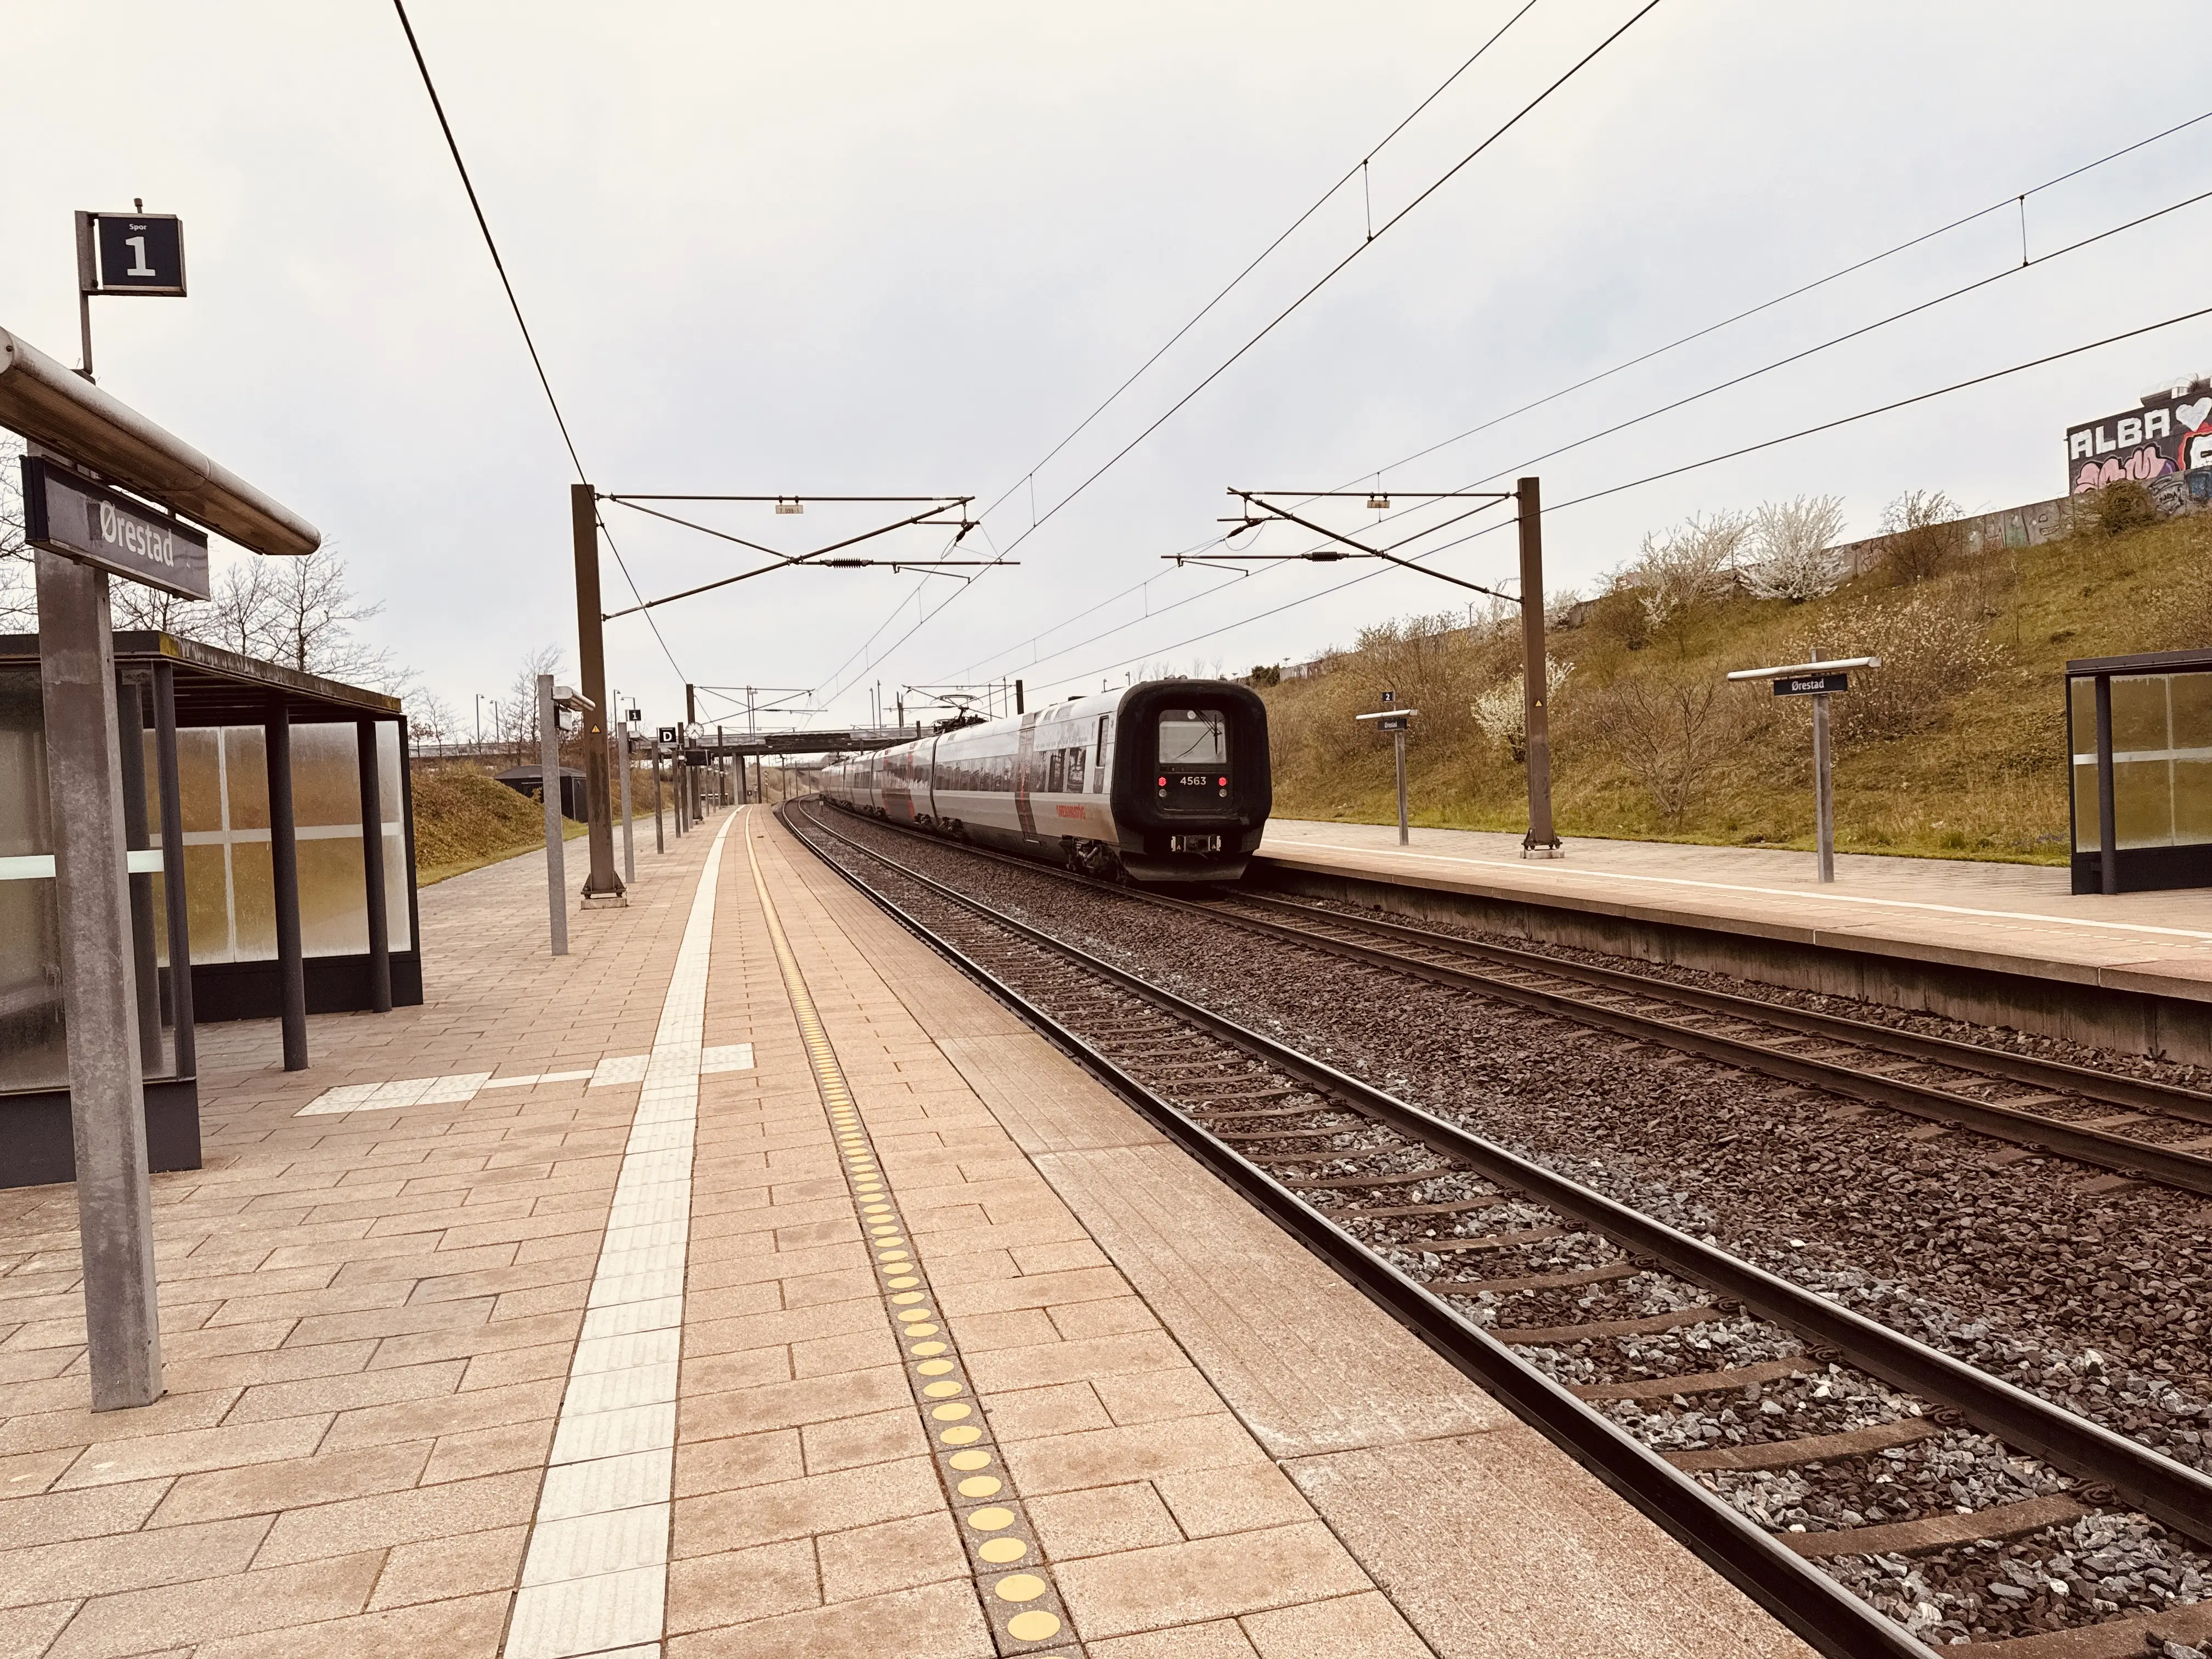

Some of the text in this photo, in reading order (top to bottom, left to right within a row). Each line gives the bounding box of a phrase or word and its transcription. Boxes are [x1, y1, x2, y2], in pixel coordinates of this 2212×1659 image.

[129, 223, 148, 232] Spor
[125, 236, 156, 276] 1
[2069, 408, 2170, 460] ALBA
[100, 500, 174, 567] Ørestad
[1791, 678, 1825, 691] Ørestad
[663, 731, 673, 742] D
[1180, 776, 1206, 785] 4563
